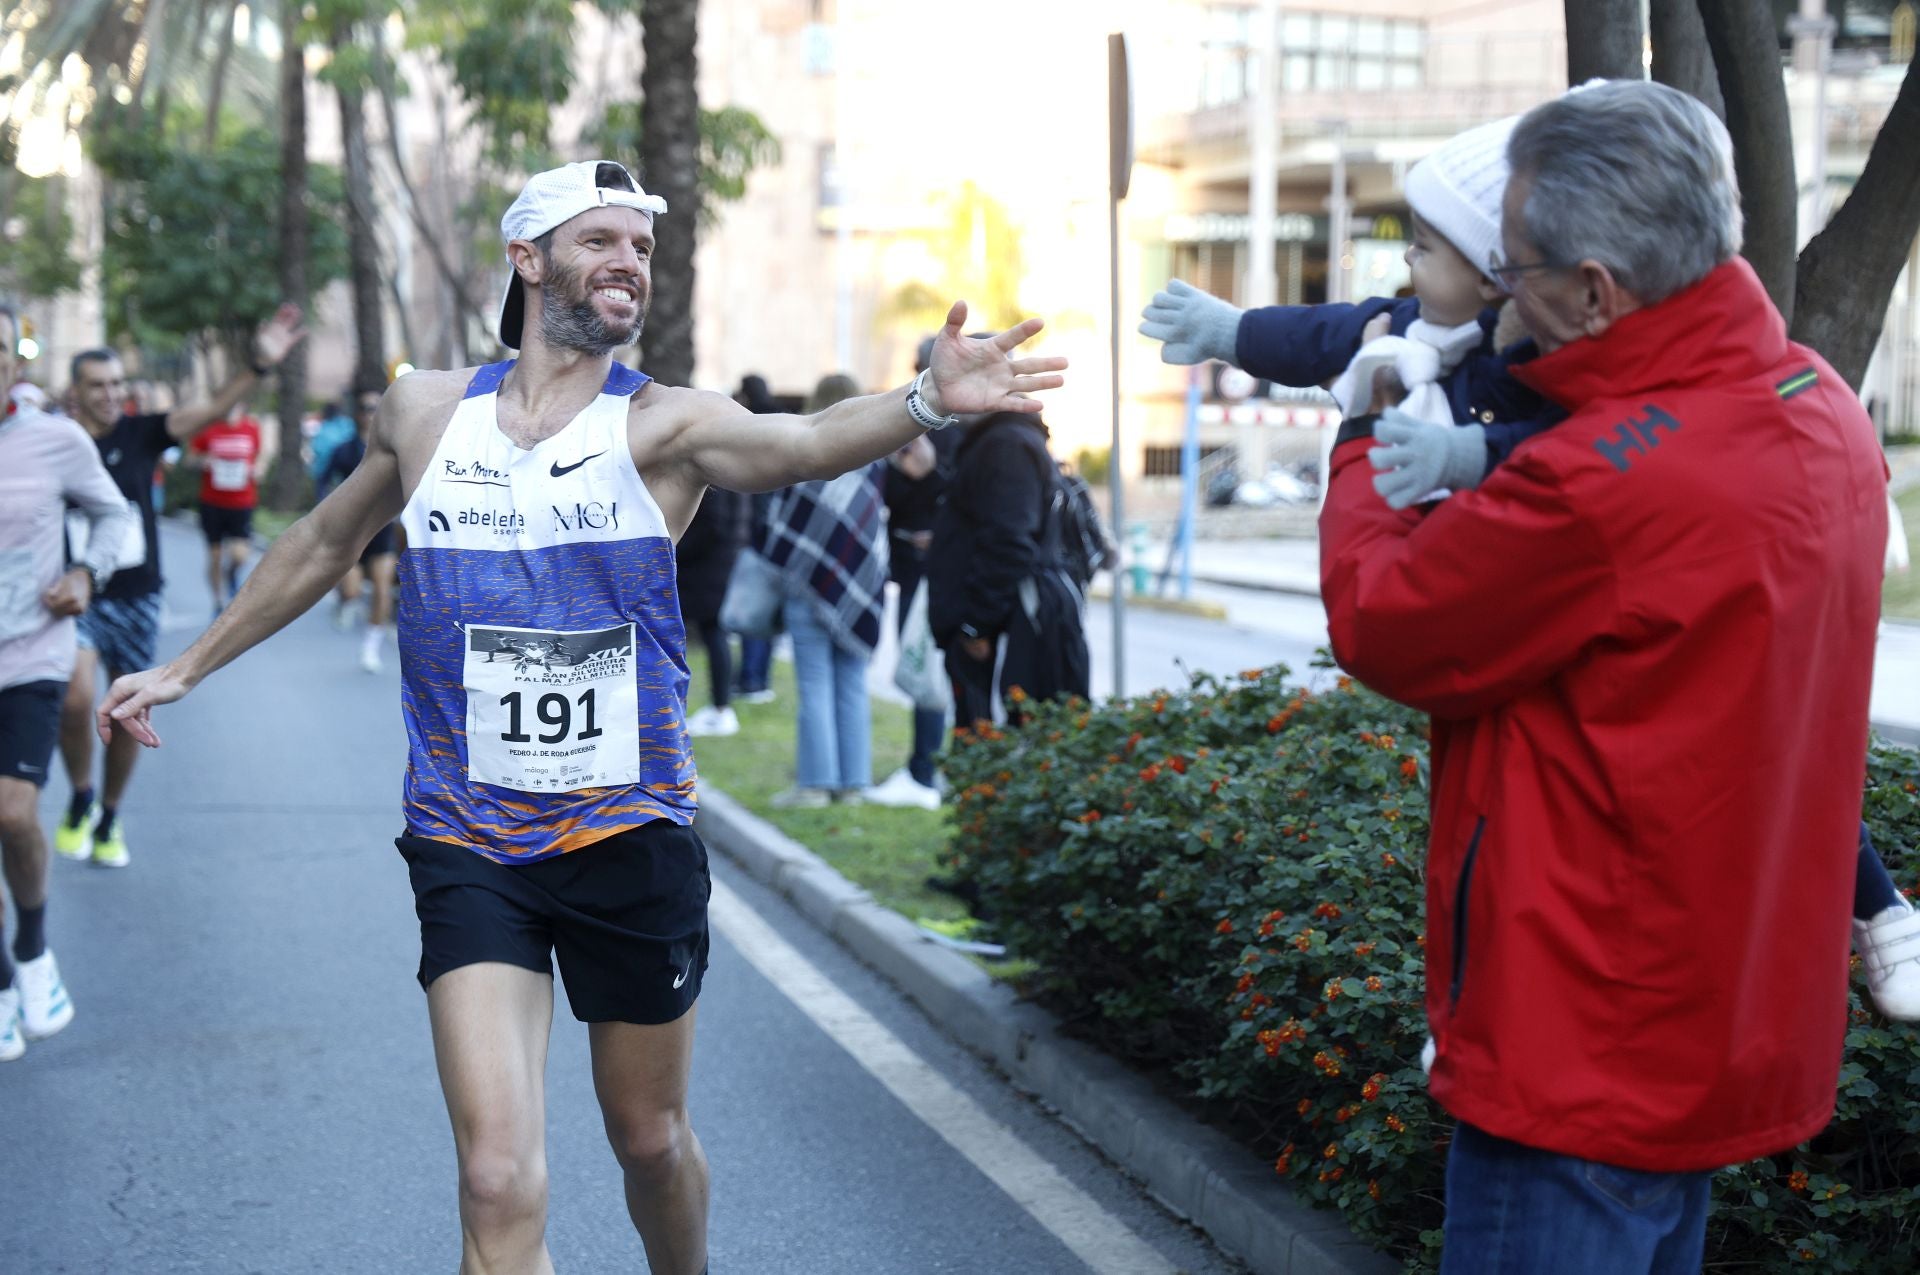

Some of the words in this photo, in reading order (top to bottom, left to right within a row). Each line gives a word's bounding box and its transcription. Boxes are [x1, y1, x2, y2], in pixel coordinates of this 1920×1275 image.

[1593, 403, 1683, 473] HH
[445, 459, 467, 476] Run
[583, 645, 631, 663] XIV
[571, 663, 627, 677] SILVESTRE
[574, 657, 627, 672] CARRERA
[514, 676, 562, 684] PALMA
[568, 668, 627, 683] PALMILLA
[500, 688, 603, 744] 191
[509, 749, 531, 757] PEDRO
[550, 750, 570, 758] RODA
